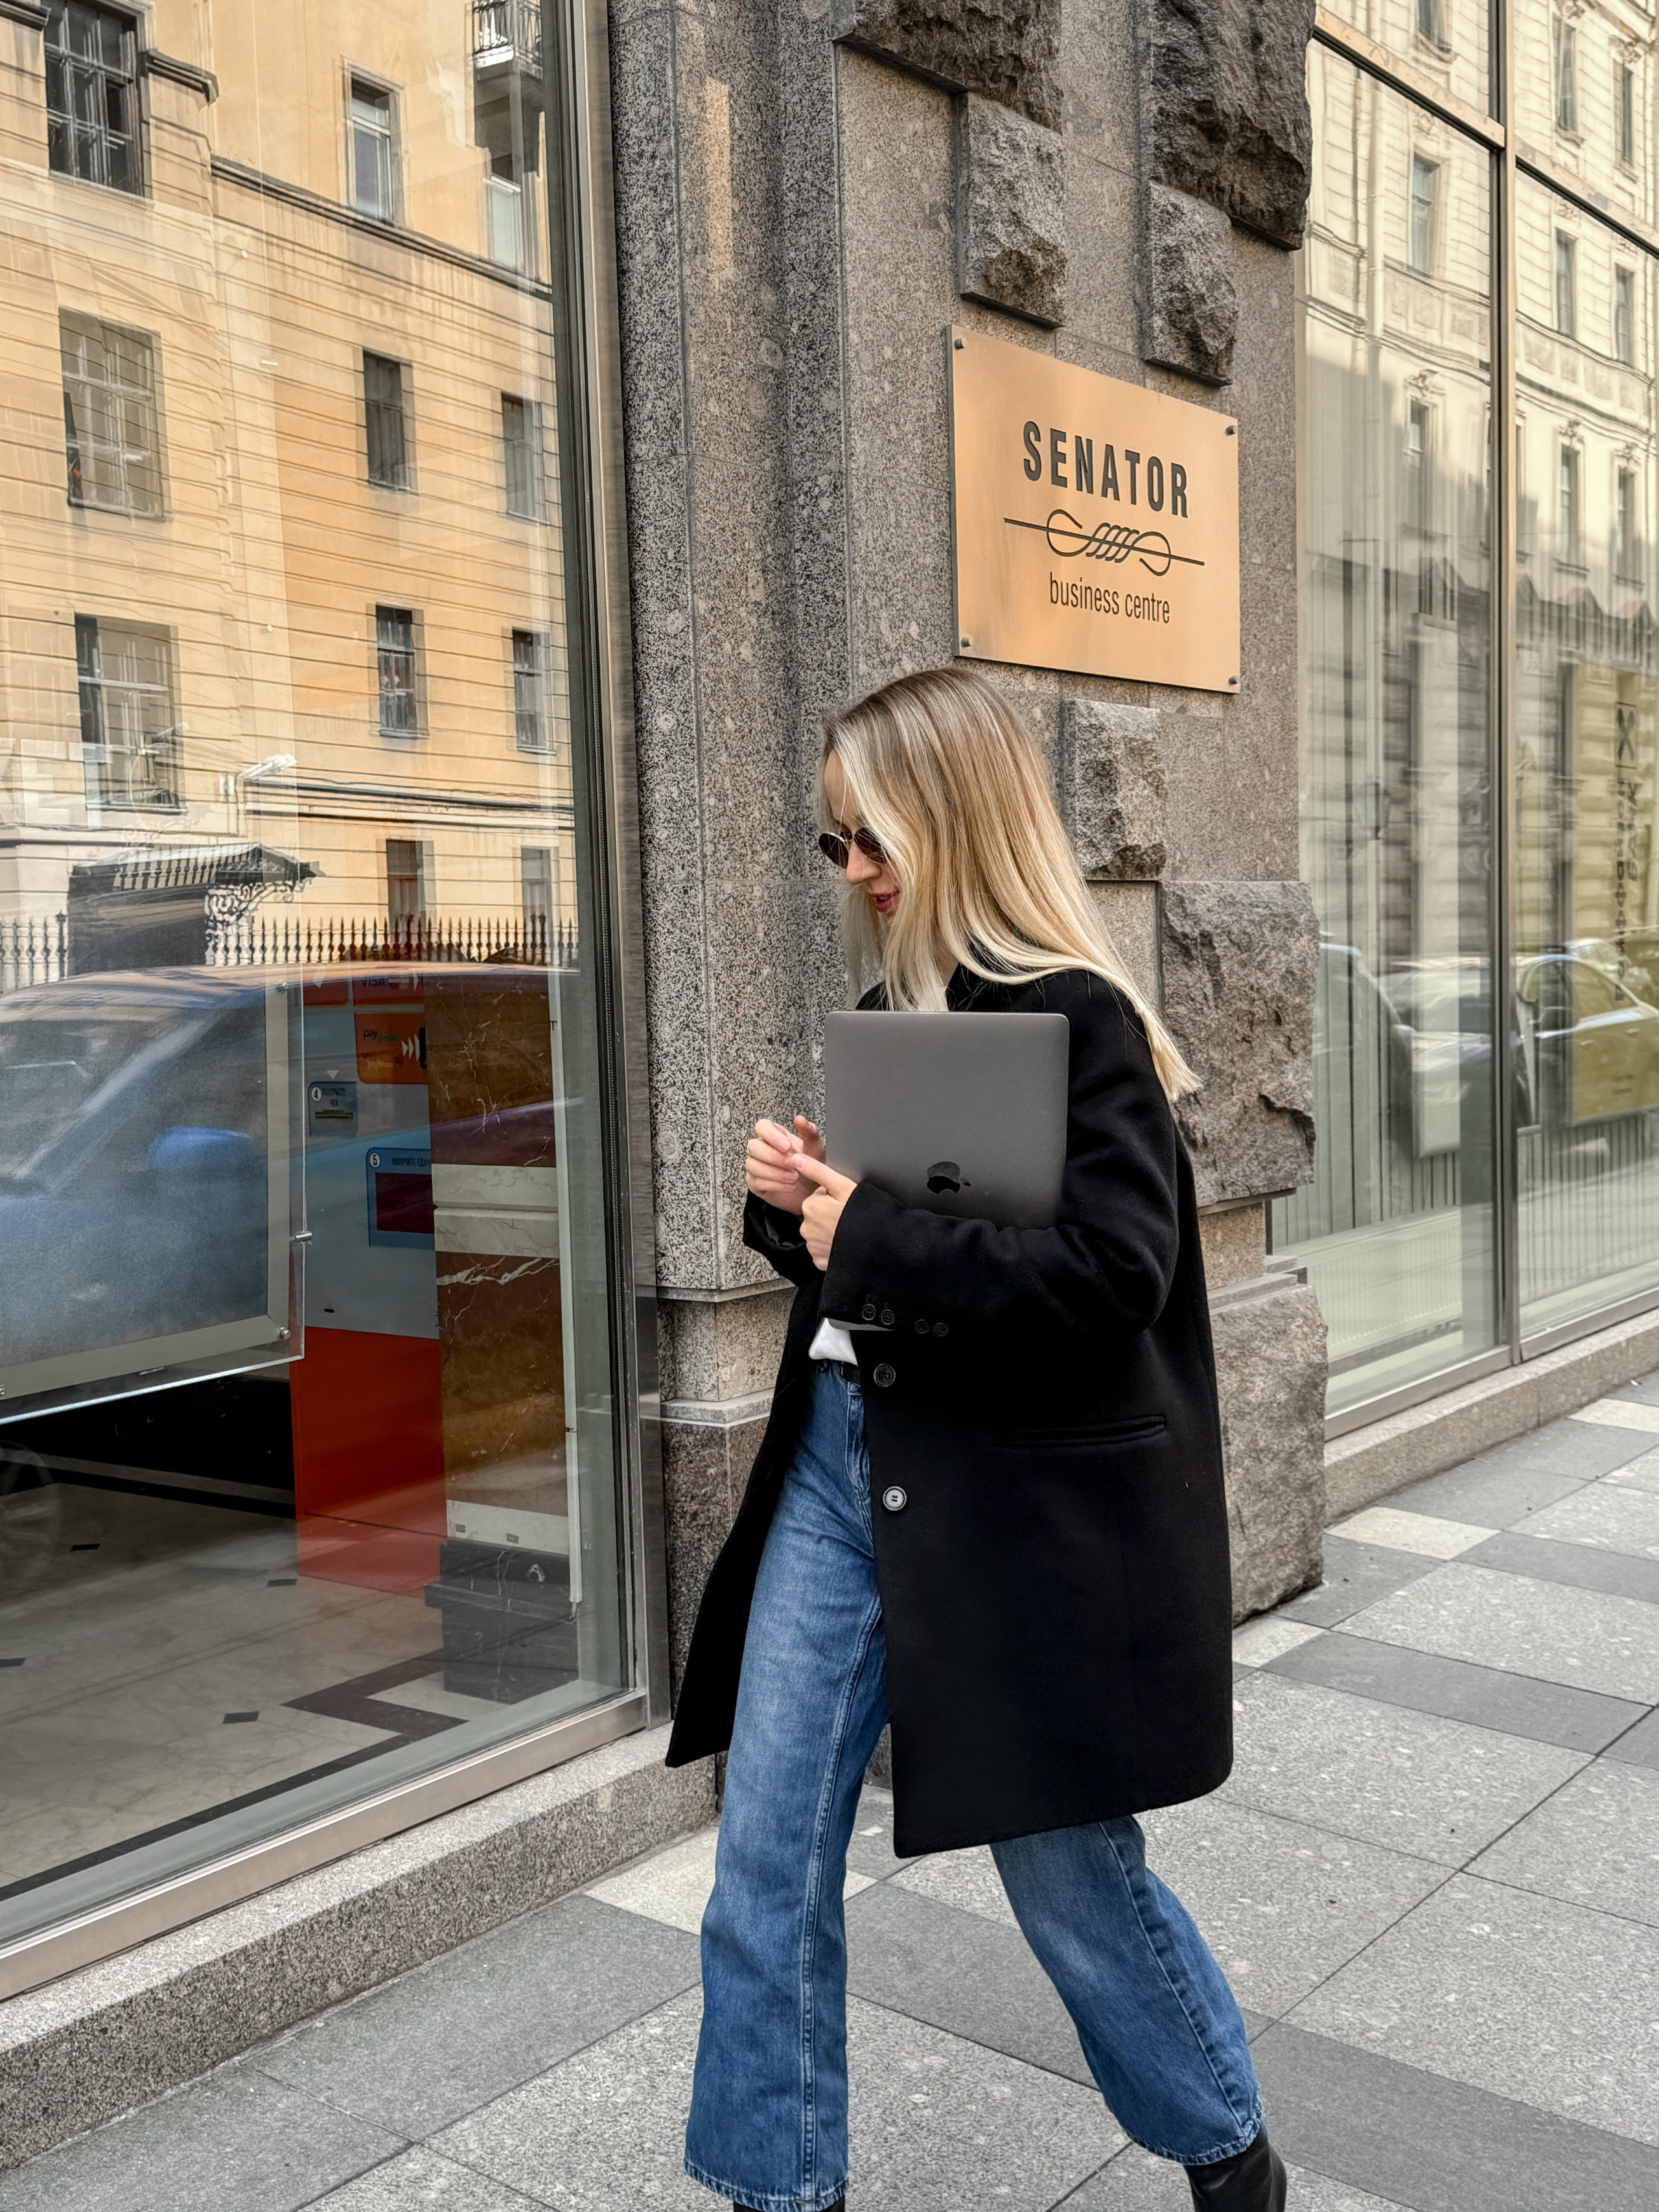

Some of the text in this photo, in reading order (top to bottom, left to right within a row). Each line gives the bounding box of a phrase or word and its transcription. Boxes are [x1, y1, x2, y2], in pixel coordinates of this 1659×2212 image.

[1023, 421, 1189, 518] SENATOR
[1050, 571, 1170, 624] business centre
[313, 1088, 319, 1100] 4
